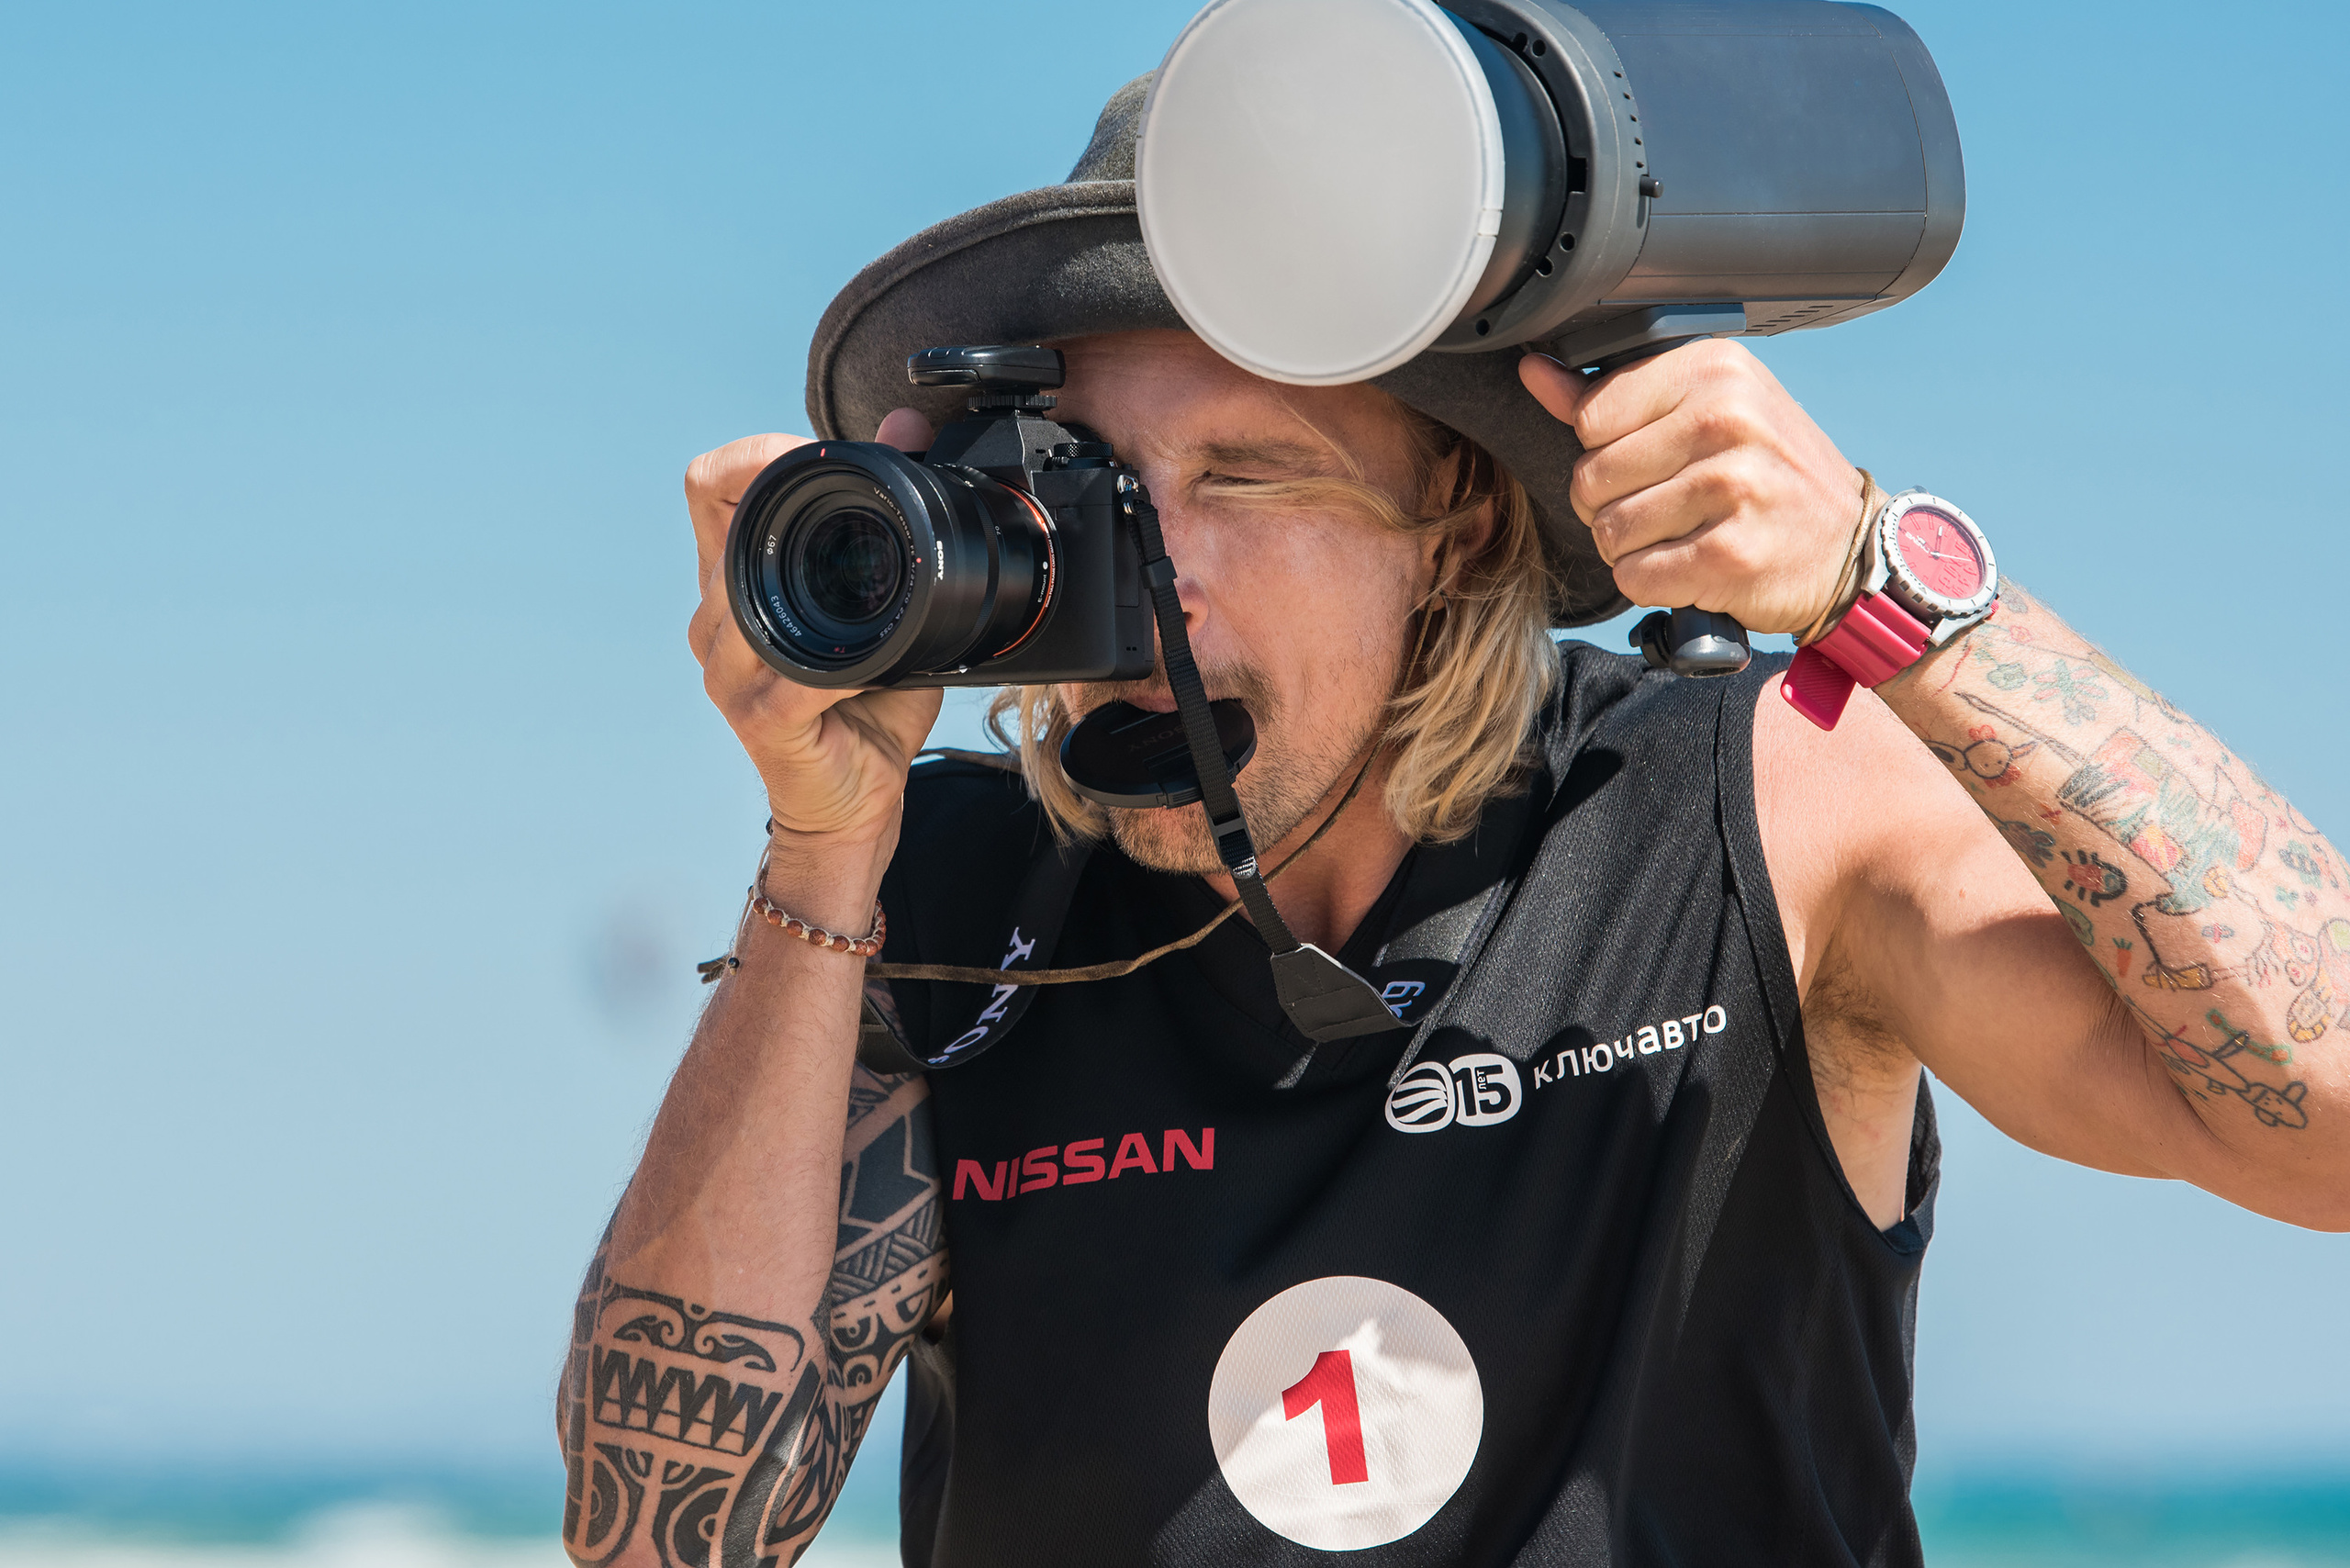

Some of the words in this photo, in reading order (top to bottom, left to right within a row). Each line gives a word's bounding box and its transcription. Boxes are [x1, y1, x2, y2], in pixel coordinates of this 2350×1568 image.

[873, 487, 912, 540] Vario-Tessar
[994, 525, 1002, 536] 70
[936, 540, 945, 581] SONY
[1037, 574, 1046, 603] E-mount
[770, 595, 802, 637] 46426043
[927, 926, 1036, 1065] SONY
[1534, 1004, 1728, 1090] ключавто
[953, 1127, 1215, 1201] NISSAN
[1281, 1349, 1369, 1485] 1
